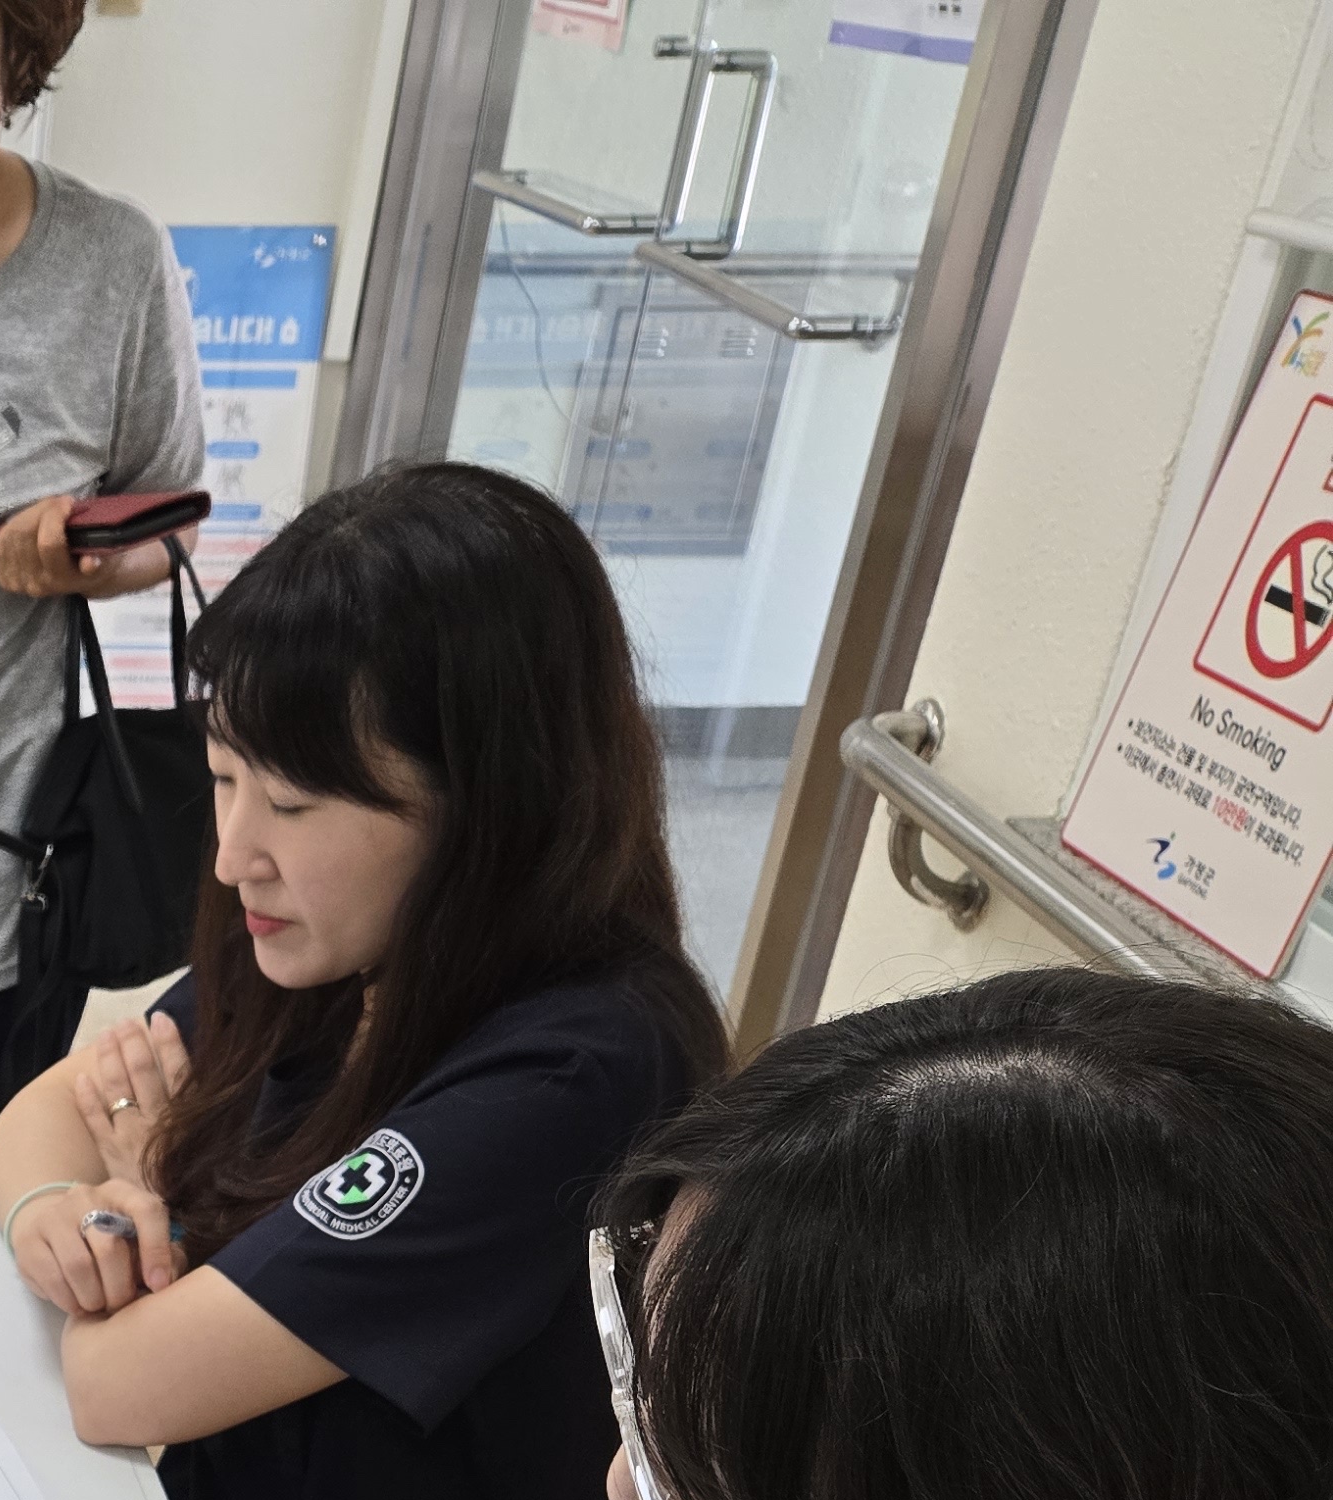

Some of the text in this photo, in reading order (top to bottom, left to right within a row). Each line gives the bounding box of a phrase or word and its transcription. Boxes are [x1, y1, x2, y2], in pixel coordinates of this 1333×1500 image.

[1190, 695, 1287, 772] No Smoking
[1176, 742, 1197, 767] 건물
[1194, 753, 1208, 775] 및
[1184, 854, 1216, 886] 가평군
[330, 1185, 409, 1233] MEDICAL CENTER
